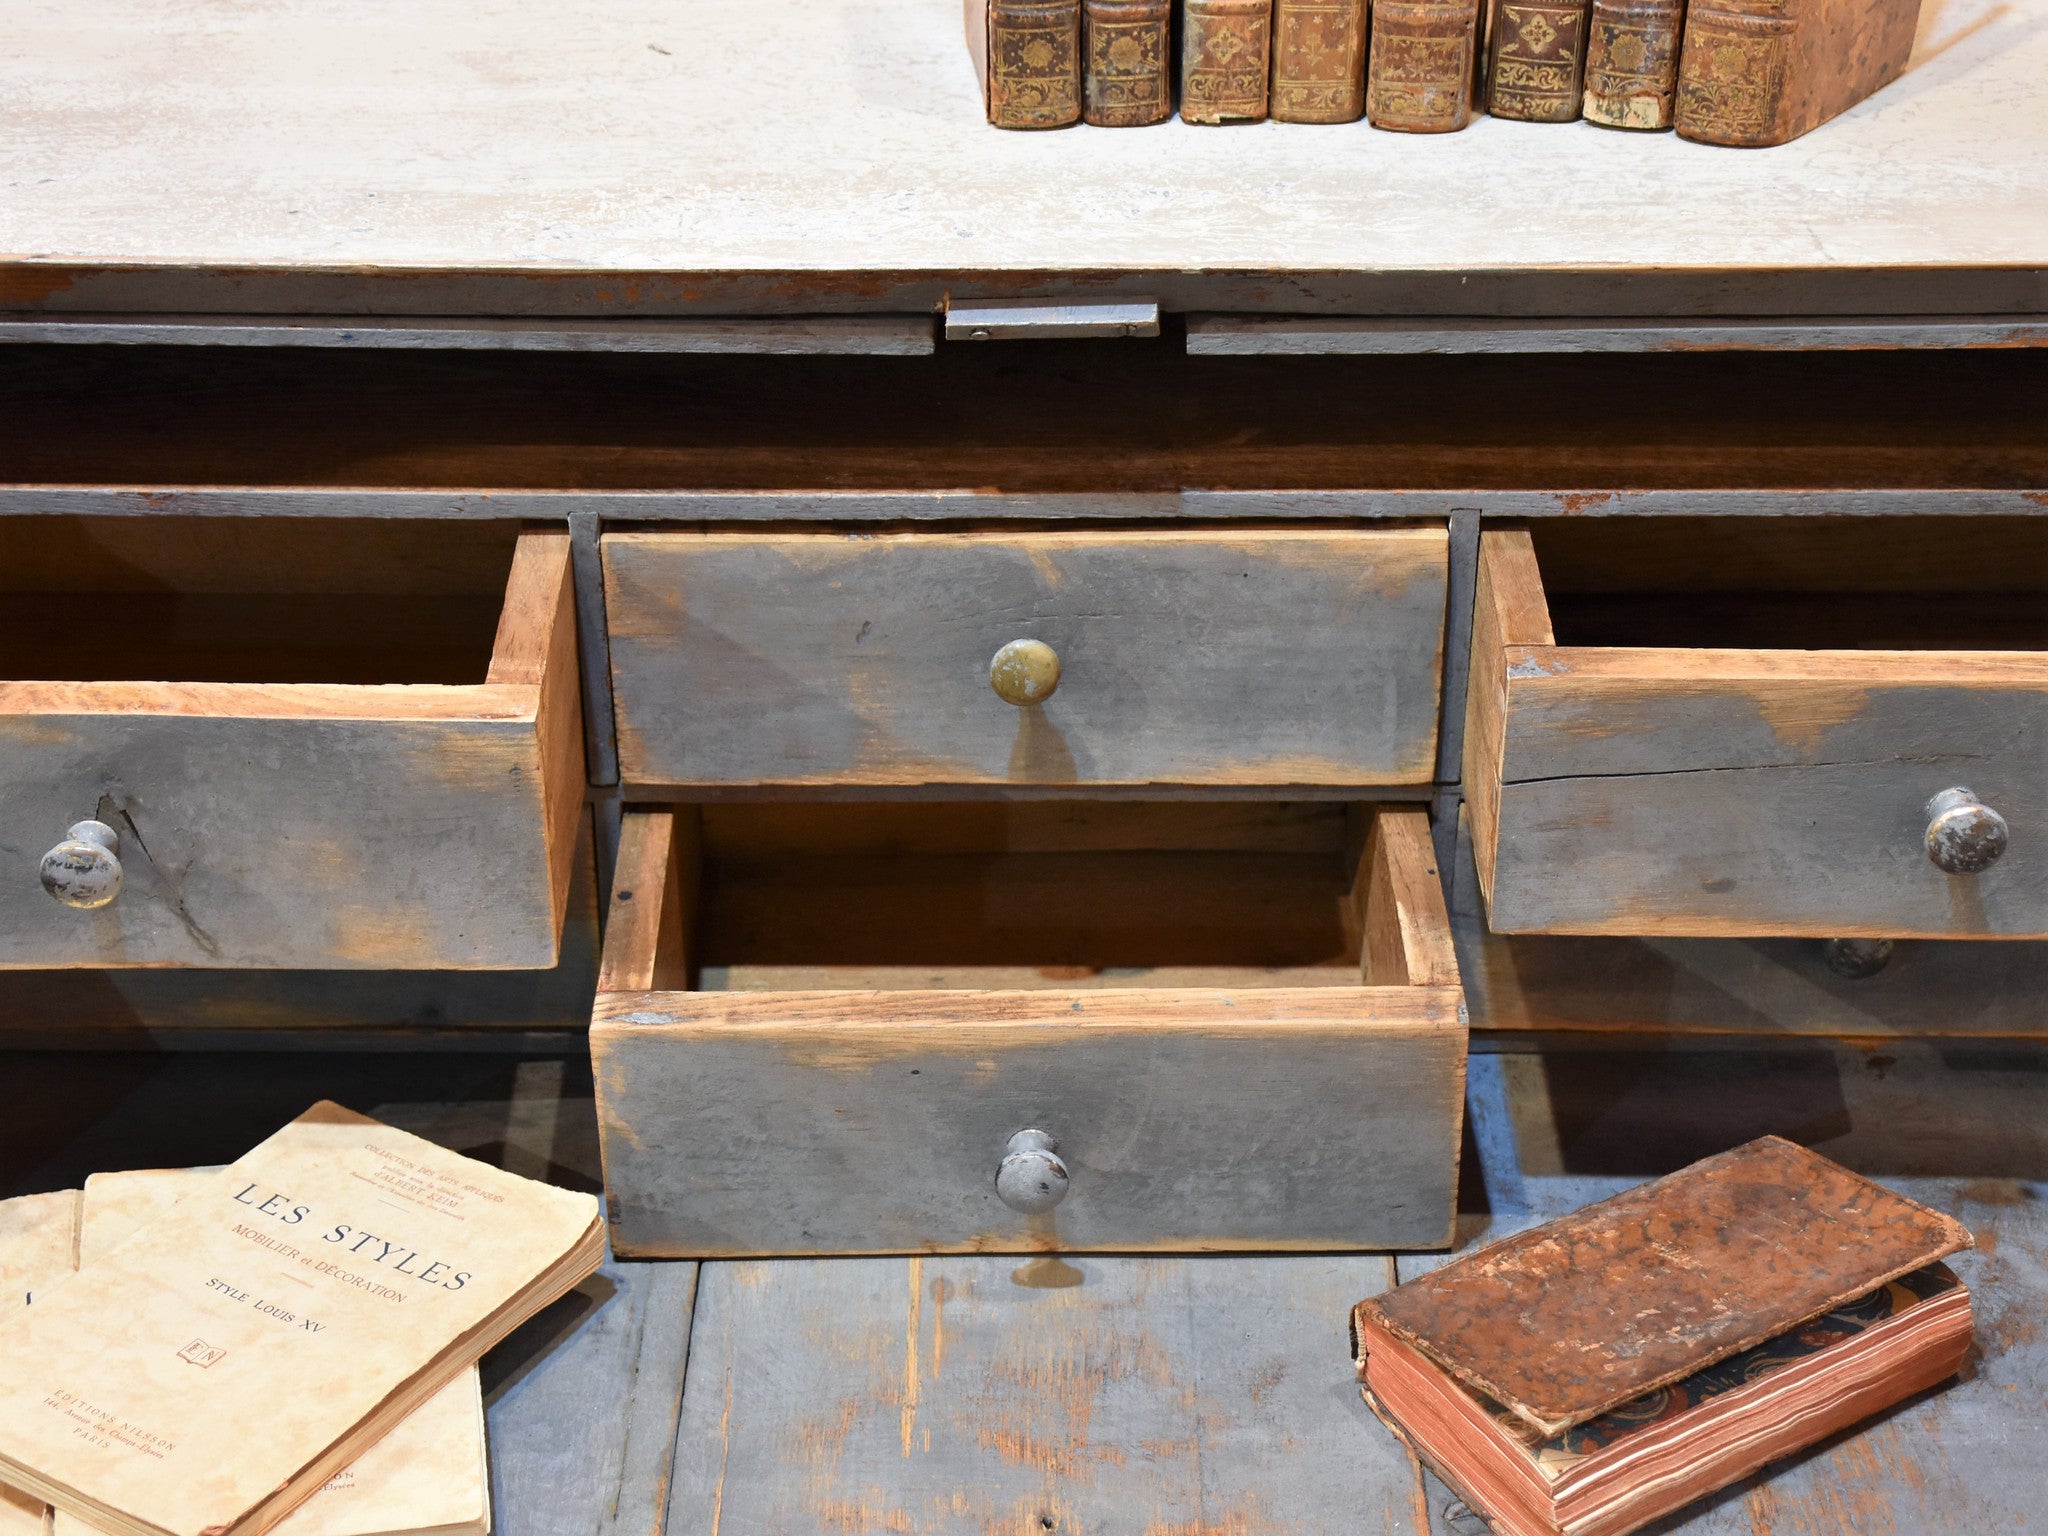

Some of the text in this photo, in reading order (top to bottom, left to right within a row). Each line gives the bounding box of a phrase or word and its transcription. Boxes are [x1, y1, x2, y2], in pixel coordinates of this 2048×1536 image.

[418, 1167, 434, 1177] DES
[427, 1193, 458, 1208] KEIM
[233, 1183, 311, 1225] LES
[321, 1224, 473, 1291] STYLES
[231, 1224, 407, 1302] MOBILIER et DÉCORATION
[206, 1278, 326, 1333] STYLE LOUIS XV
[64, 1409, 91, 1424] Avenue
[93, 1423, 105, 1432] des
[73, 1427, 111, 1449] PARIS
[120, 1422, 176, 1451] NILSSON
